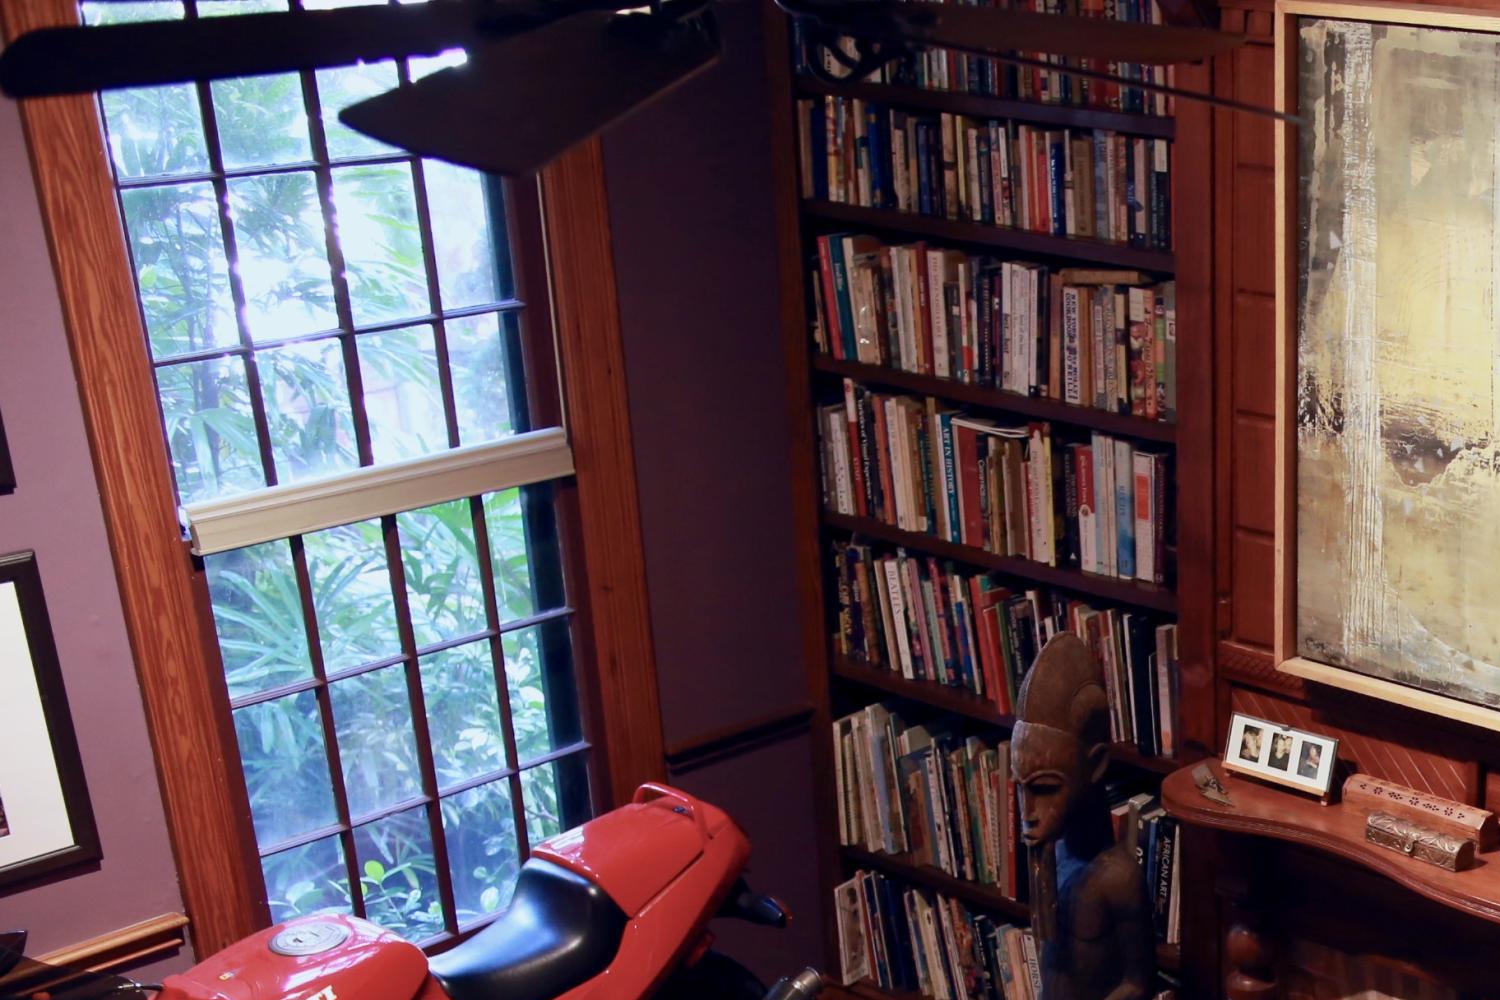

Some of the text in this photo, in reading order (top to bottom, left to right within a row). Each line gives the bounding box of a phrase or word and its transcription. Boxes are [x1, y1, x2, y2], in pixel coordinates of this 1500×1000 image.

[857, 398, 866, 431] Varieties
[860, 439, 869, 460] Visual
[942, 427, 950, 444] ART
[944, 446, 951, 456] IN
[861, 461, 873, 500] Experience
[945, 457, 955, 493] HISTORY
[887, 569, 904, 614] BEATLES
[1159, 835, 1171, 897] AFRICAN ART
